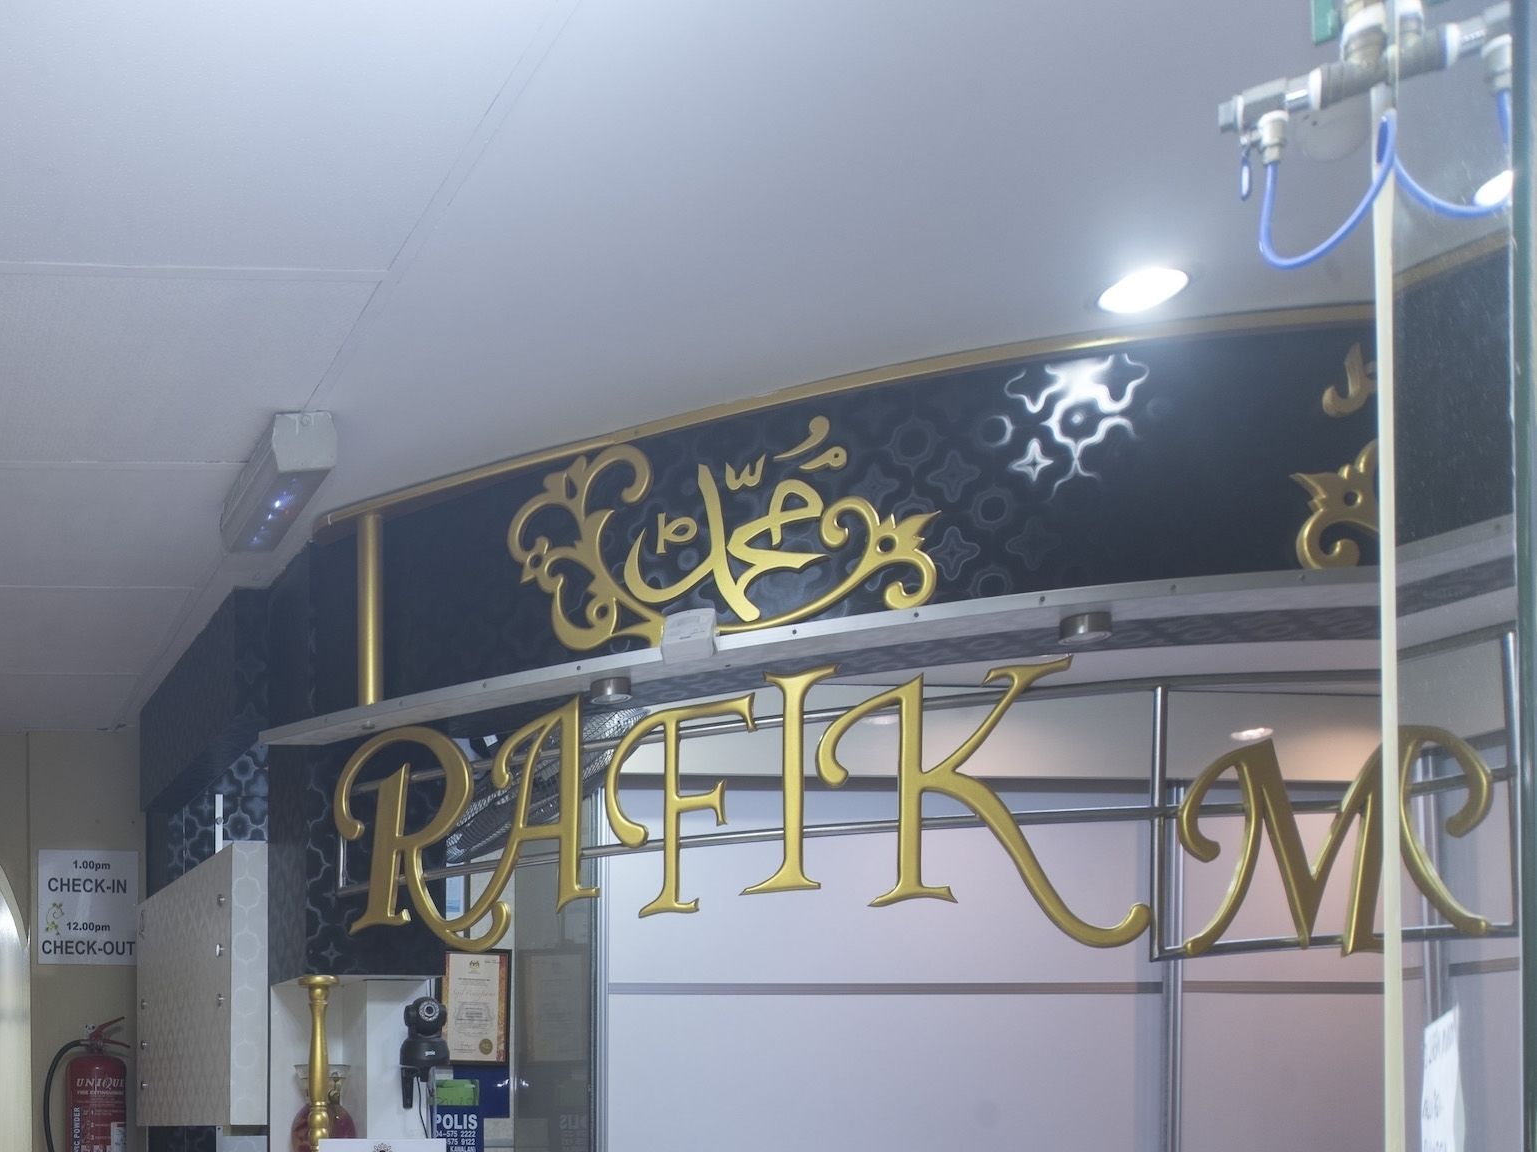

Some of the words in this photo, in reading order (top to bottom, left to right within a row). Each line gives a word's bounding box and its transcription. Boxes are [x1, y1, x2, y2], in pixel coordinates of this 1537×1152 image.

[334, 655, 1153, 954] RAFIK
[72, 860, 111, 871] 1.00pm
[47, 877, 128, 894] CHECK-IN
[66, 921, 111, 933] 12.00pm
[41, 939, 136, 956] CHECK-OUT
[73, 1107, 81, 1138] POWDER
[434, 1113, 478, 1130] POLIS
[460, 1130, 476, 1138] 2222
